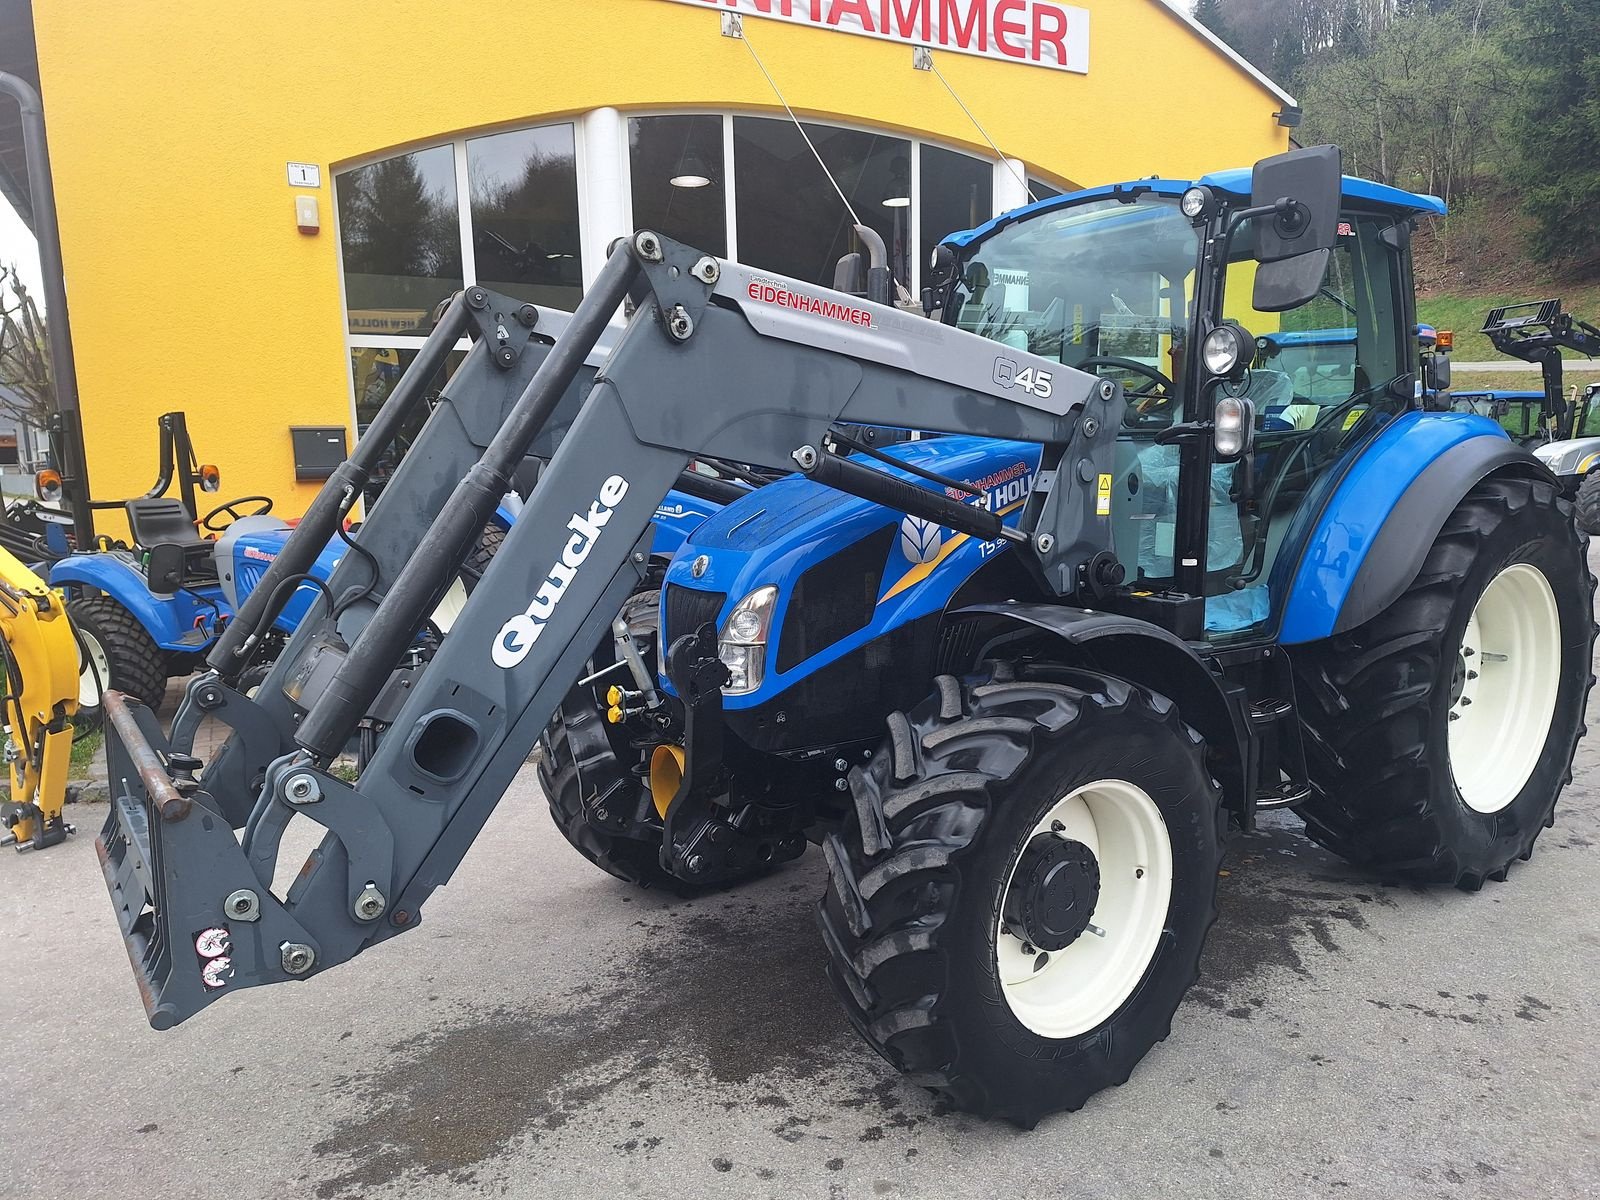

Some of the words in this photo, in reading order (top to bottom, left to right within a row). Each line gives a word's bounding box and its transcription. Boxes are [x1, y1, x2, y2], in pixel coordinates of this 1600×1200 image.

[301, 169, 306, 181] 1
[748, 283, 871, 327] EIDENHAMMER
[992, 356, 1053, 398] Q45
[491, 474, 629, 669] Quicke
